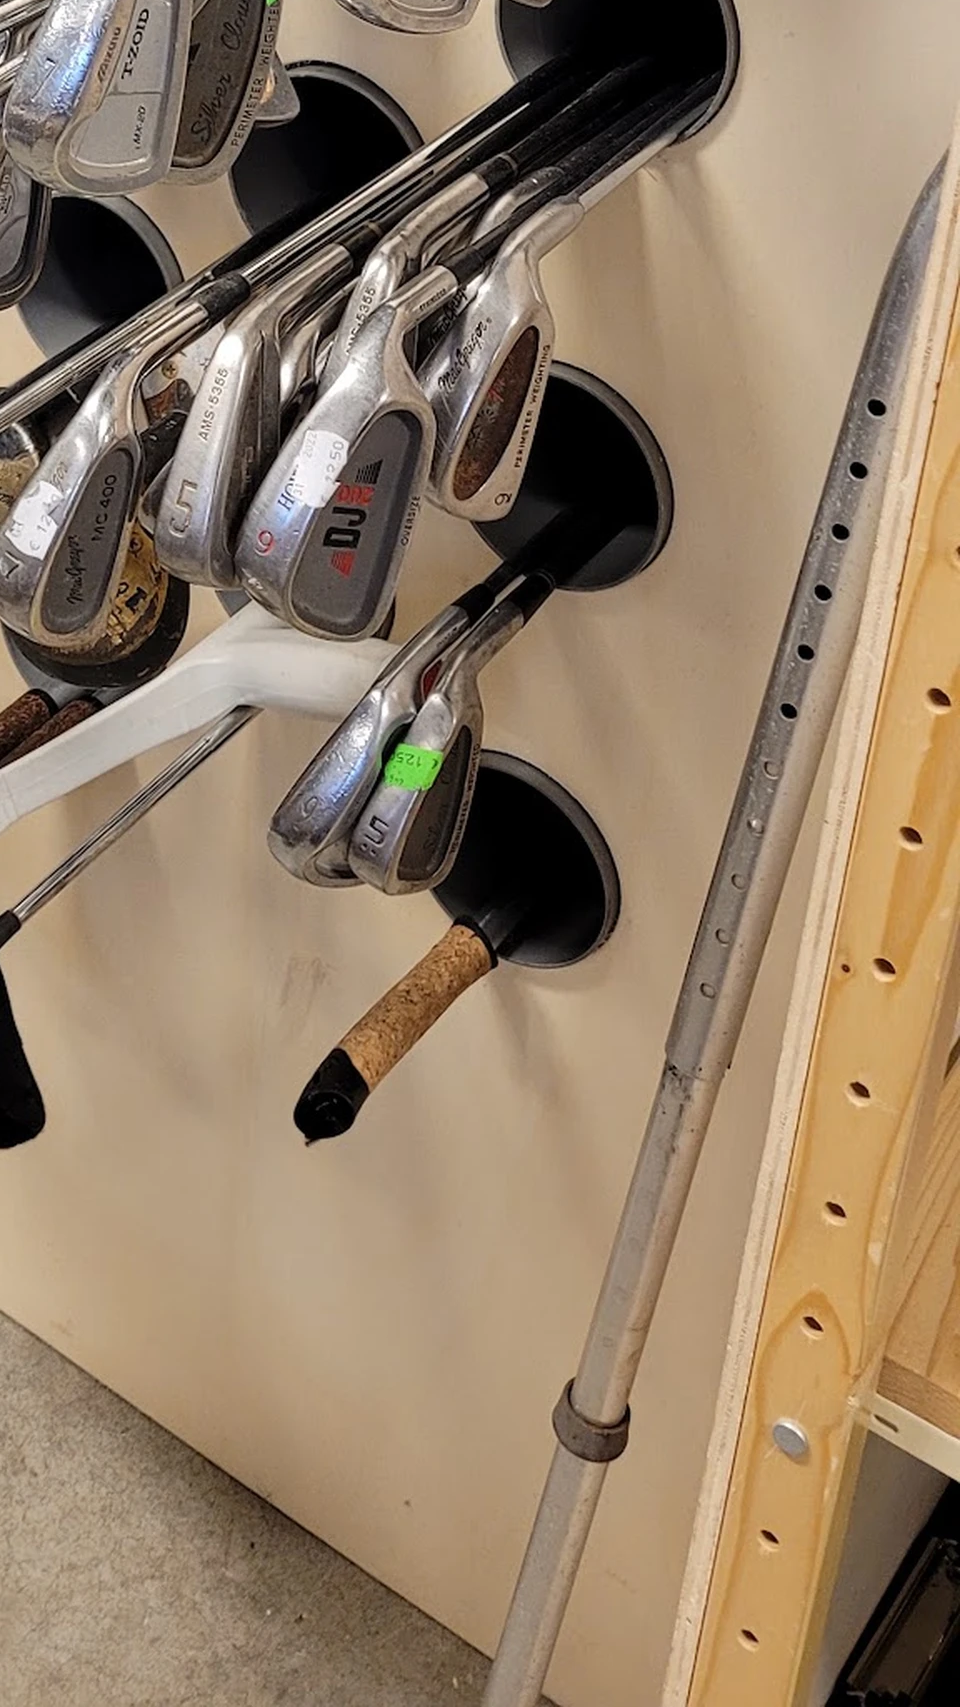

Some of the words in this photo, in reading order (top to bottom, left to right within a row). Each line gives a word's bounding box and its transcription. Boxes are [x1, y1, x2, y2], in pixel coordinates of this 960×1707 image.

[120, 7, 150, 81] T-ZOID
[192, 71, 232, 143] Silver
[230, 76, 265, 148] PERIMETER
[262, 7, 281, 73] WEIGHTE
[512, 408, 534, 469] PERIMETER
[529, 344, 552, 404] WEIGHTING
[100, 474, 117, 506] 400
[400, 494, 421, 548] OVERSIZE
[323, 505, 368, 550] DJ
[363, 815, 390, 846] 5
